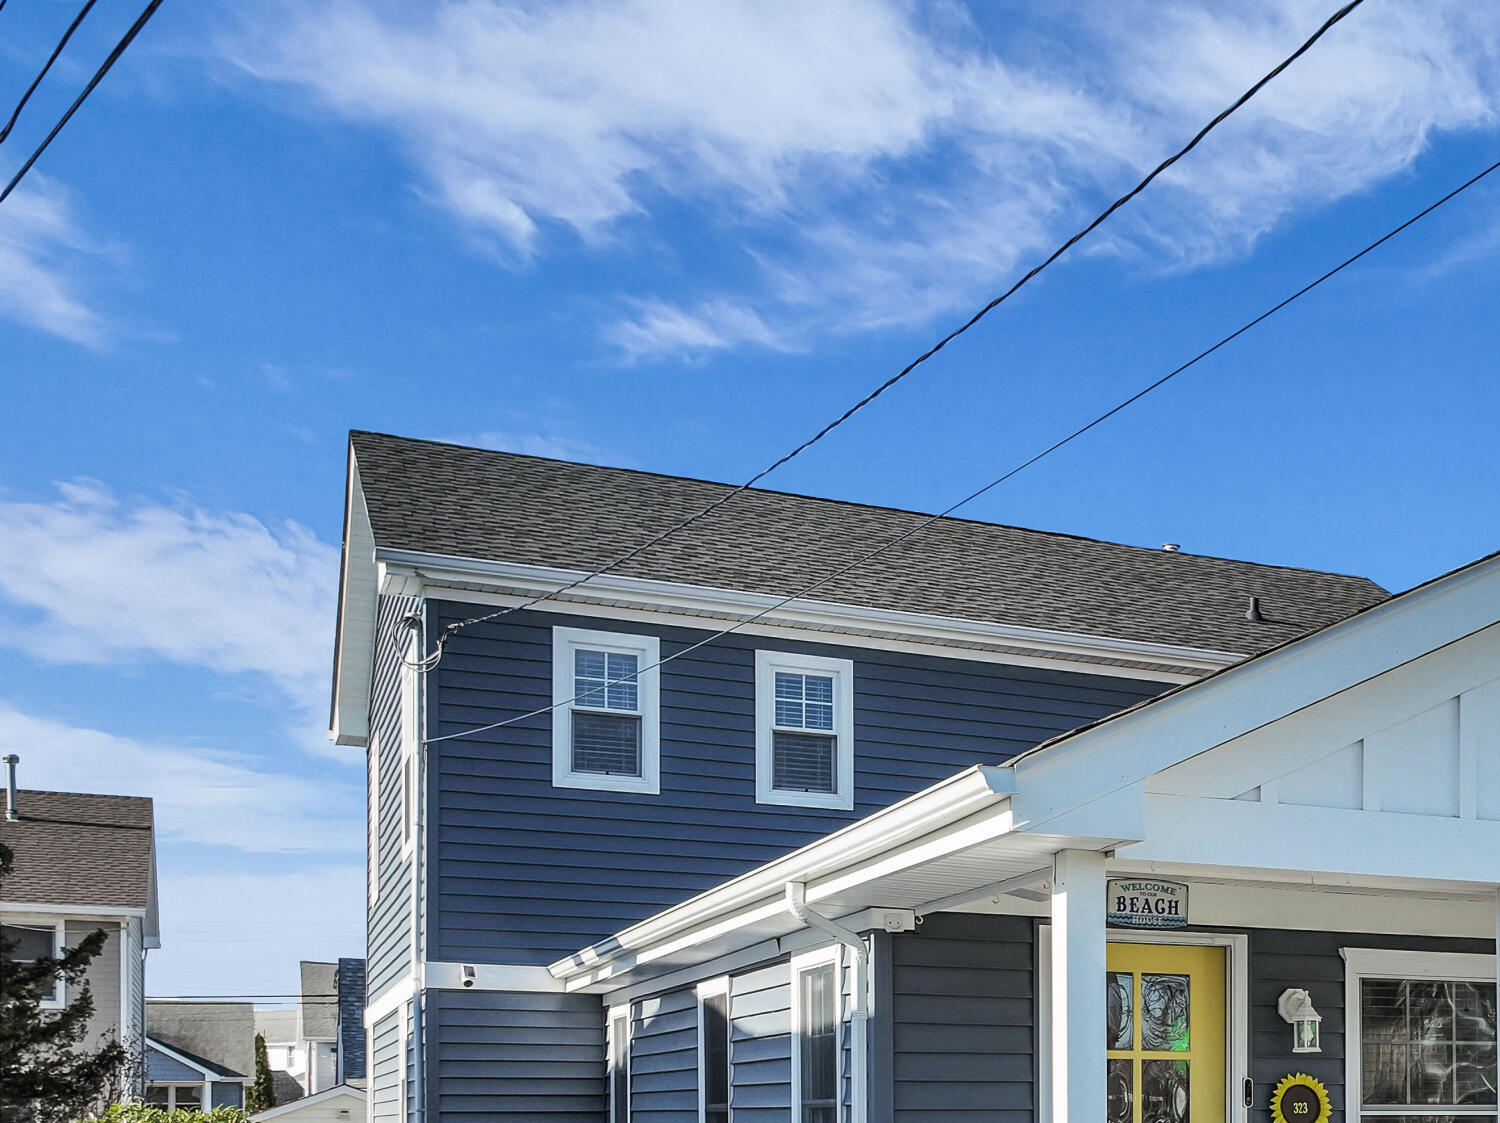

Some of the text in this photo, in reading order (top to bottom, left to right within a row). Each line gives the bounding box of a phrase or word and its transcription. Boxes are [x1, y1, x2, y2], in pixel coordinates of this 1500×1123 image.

[1120, 883, 1177, 896] WELCOME
[1132, 916, 1163, 926] HOUSE
[1293, 1102, 1308, 1114] 323
